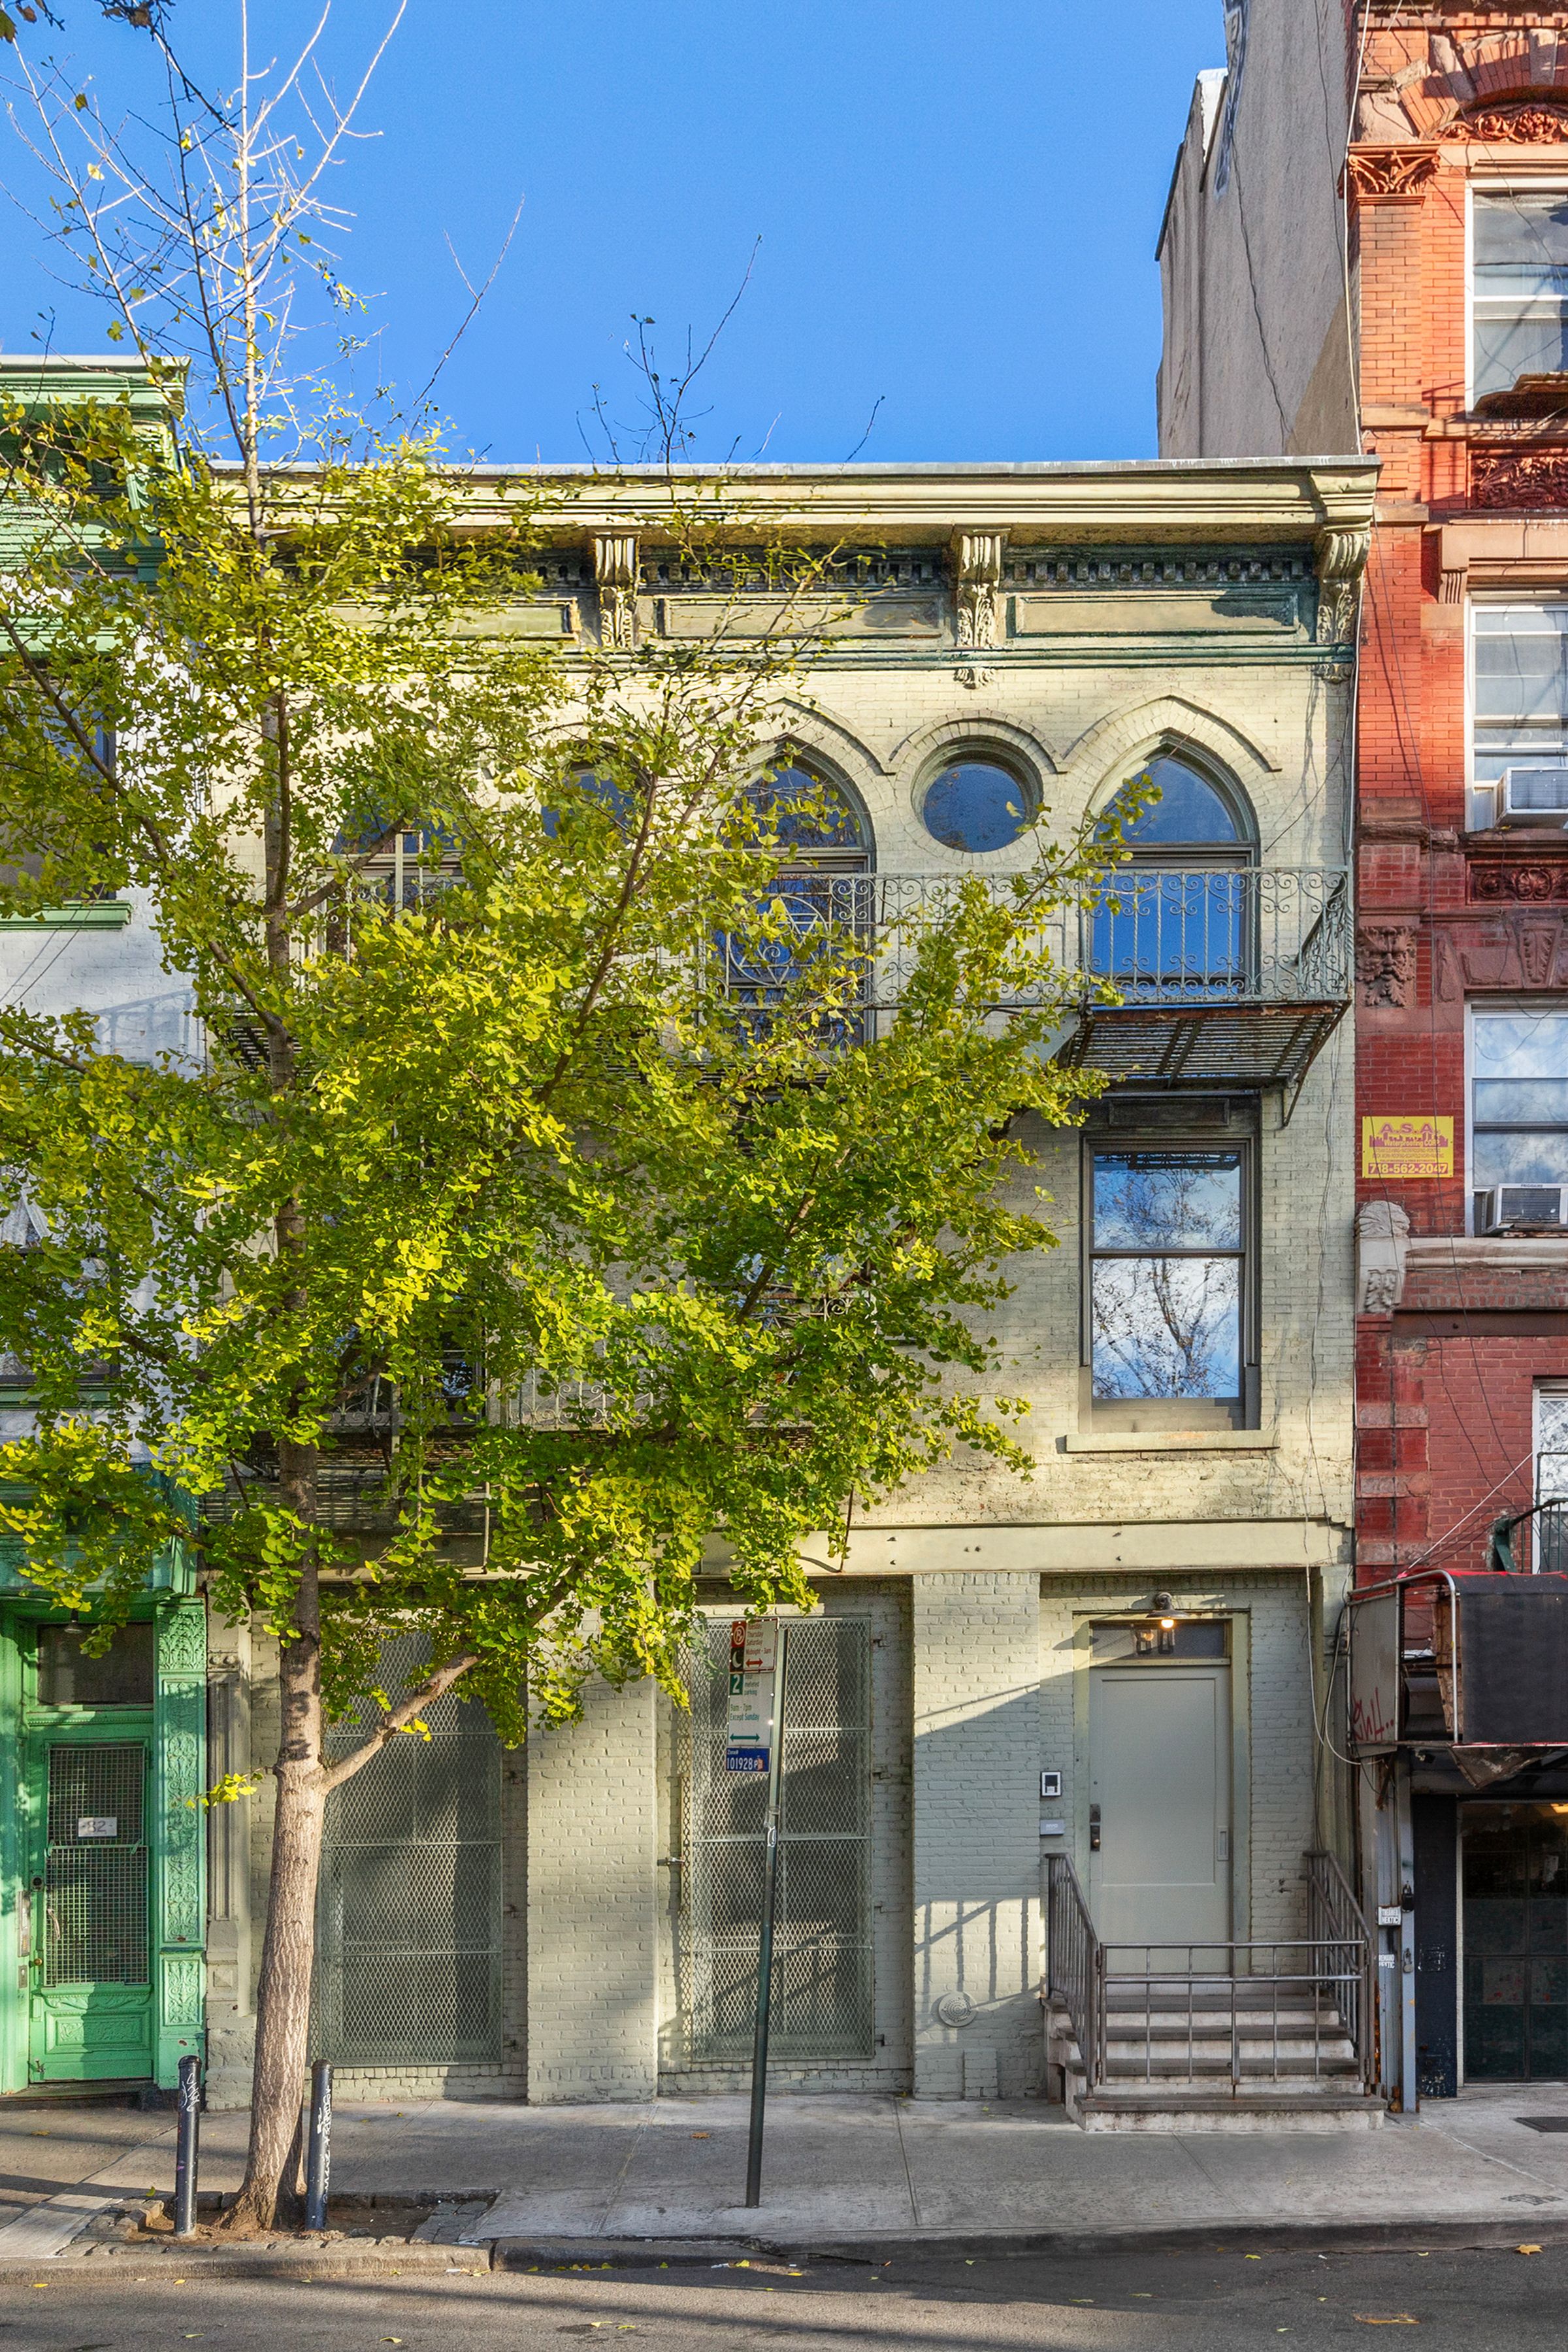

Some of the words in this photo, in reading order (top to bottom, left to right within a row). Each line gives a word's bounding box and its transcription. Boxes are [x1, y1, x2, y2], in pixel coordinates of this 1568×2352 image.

[1384, 1139, 1424, 1149] Waterproofing
[1369, 1164, 1448, 1173] 718-562-2047
[732, 1674, 740, 1693] 2
[743, 1703, 752, 1713] 7pm
[730, 1713, 744, 1722] Except
[744, 1712, 760, 1722] Sunday
[727, 1757, 753, 1771] 101928
